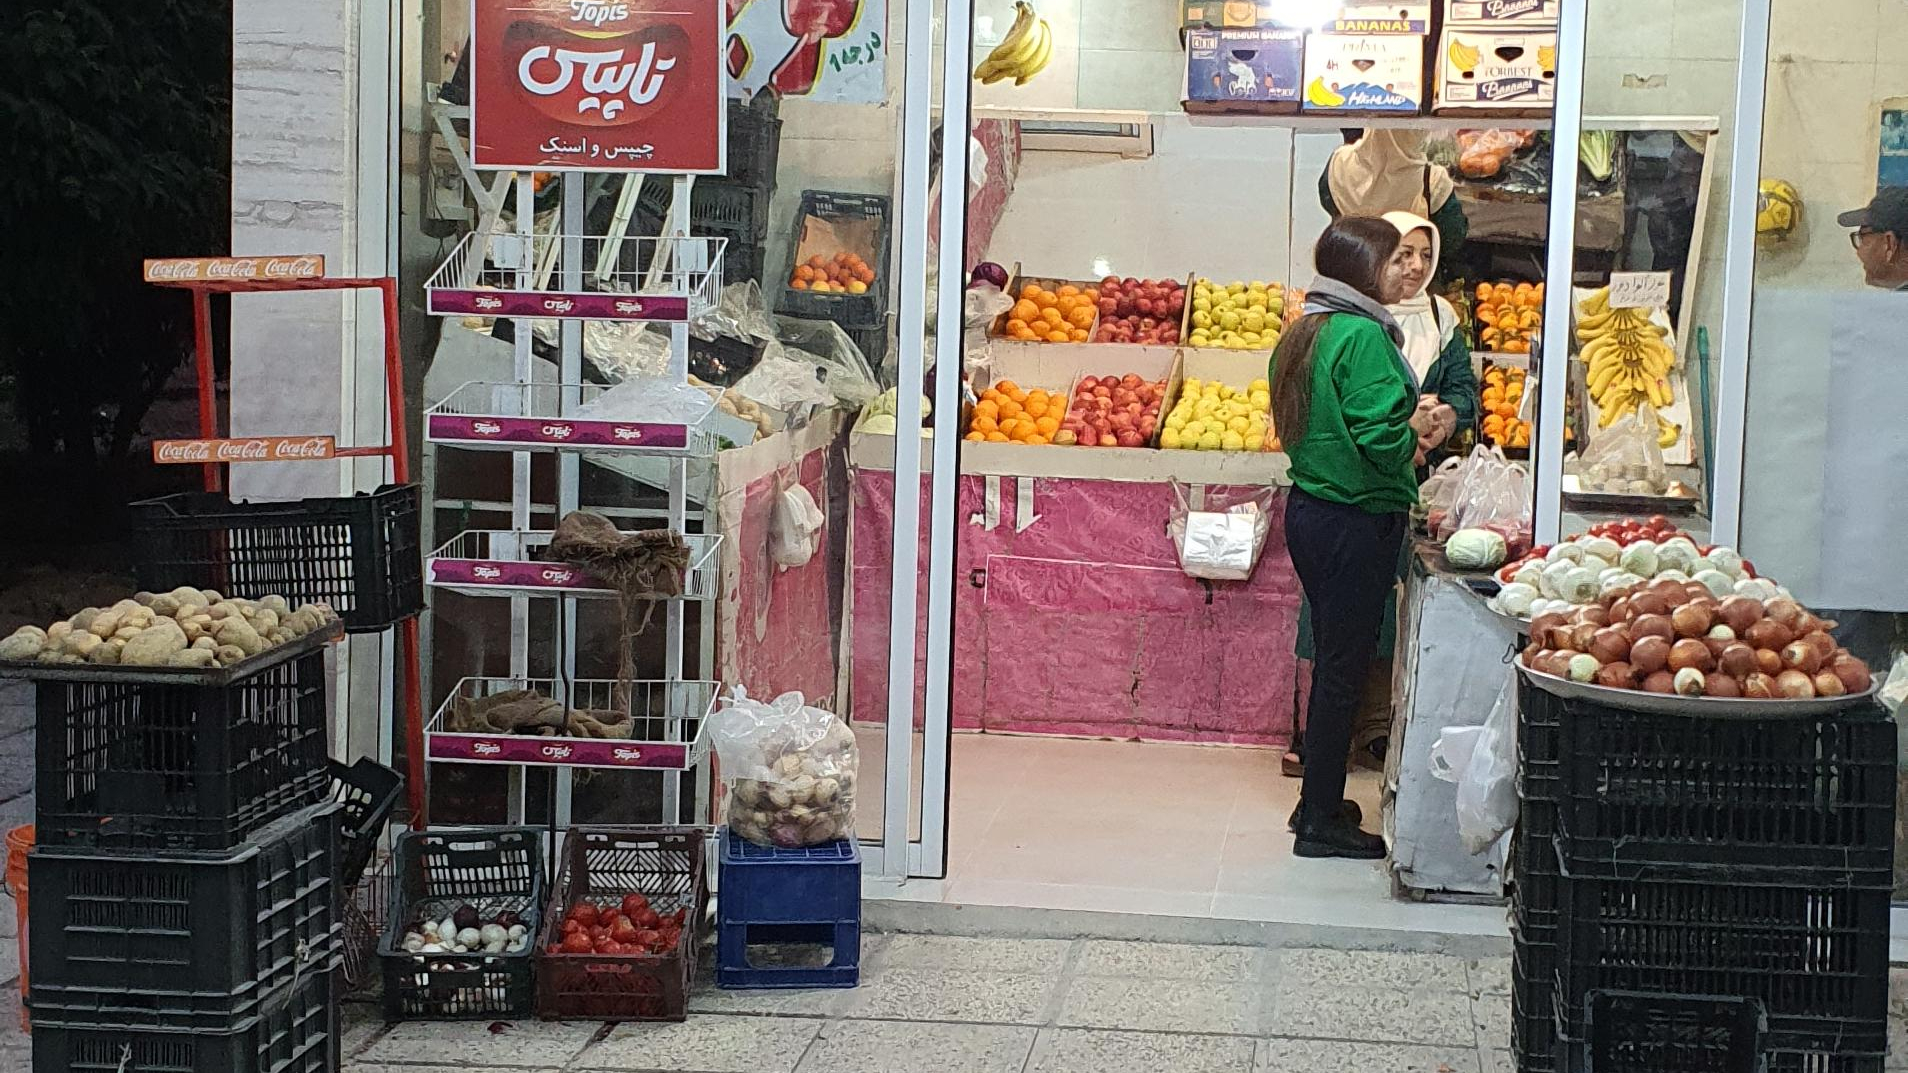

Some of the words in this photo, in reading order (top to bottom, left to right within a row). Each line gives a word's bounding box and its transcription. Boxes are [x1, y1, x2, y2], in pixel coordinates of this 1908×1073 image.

[570, 0, 629, 27] Topis
[1335, 20, 1411, 31] BANANAS
[539, 136, 587, 153] اسنک
[590, 143, 600, 158] و
[604, 143, 655, 160] چیپس
